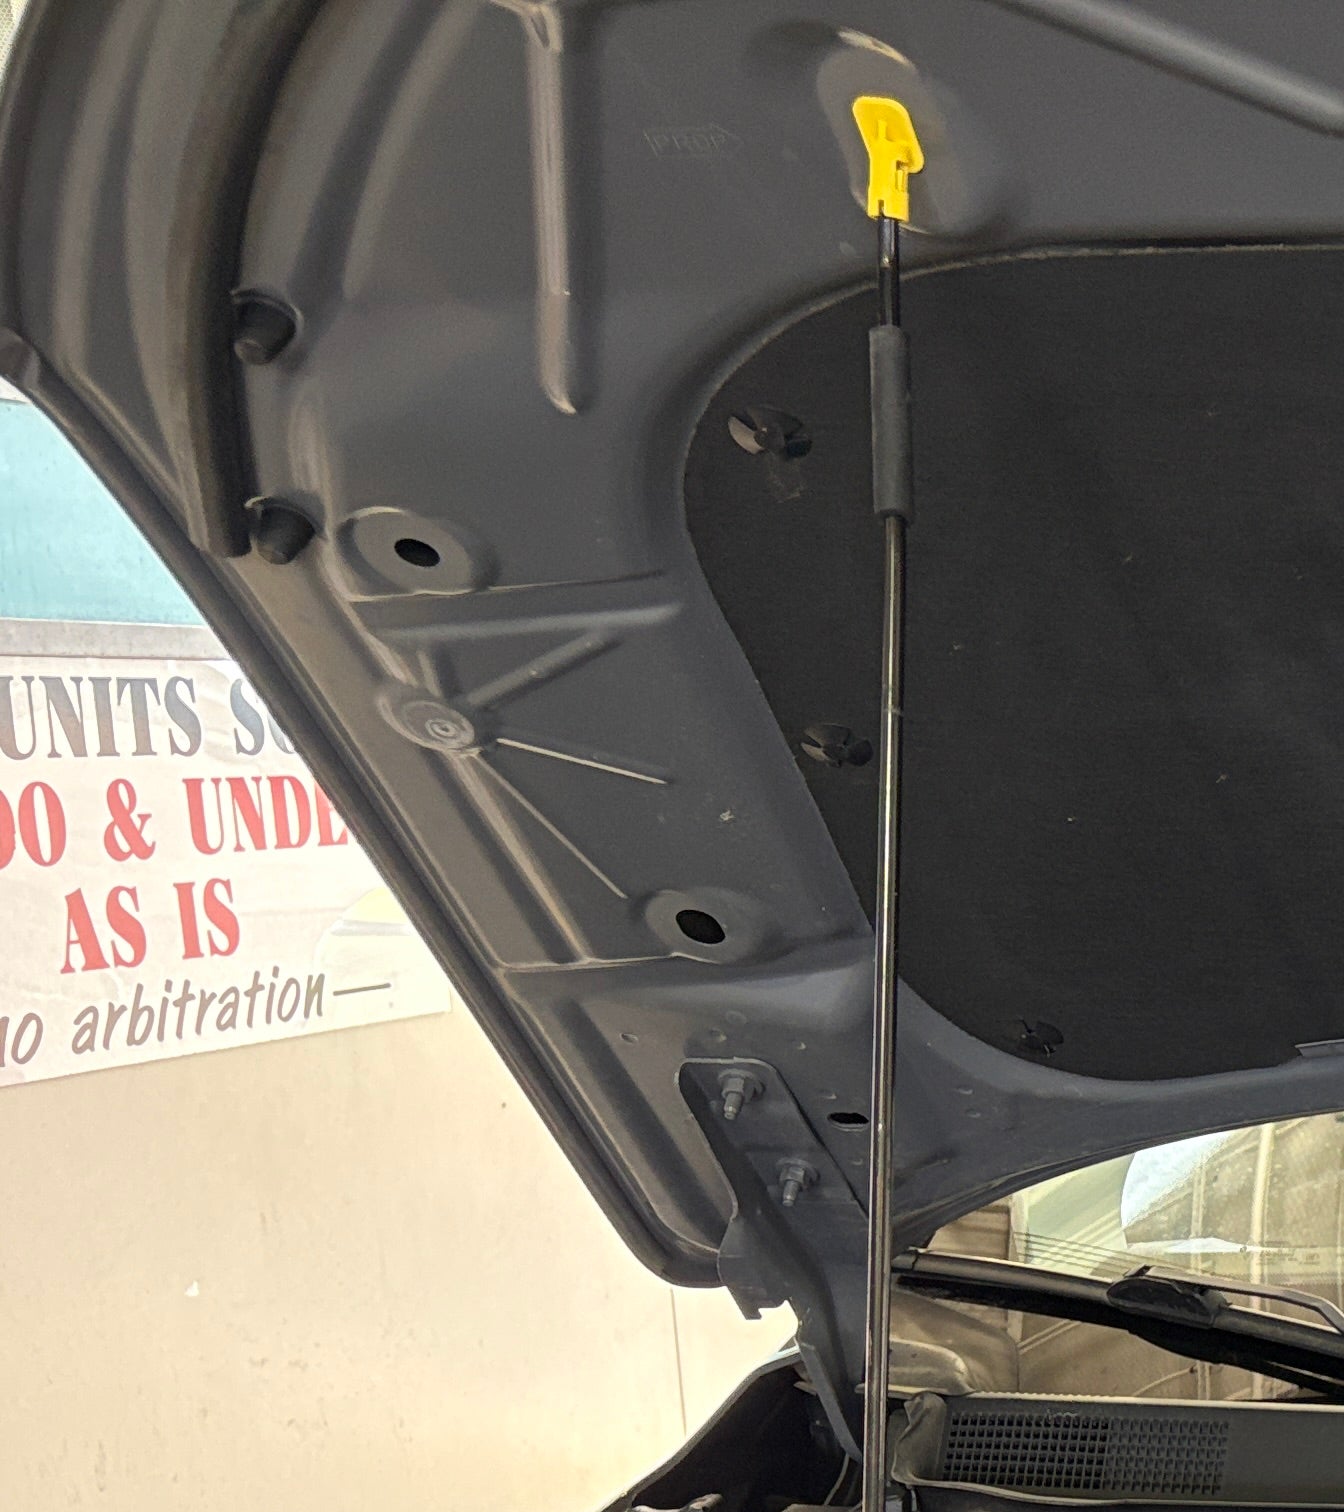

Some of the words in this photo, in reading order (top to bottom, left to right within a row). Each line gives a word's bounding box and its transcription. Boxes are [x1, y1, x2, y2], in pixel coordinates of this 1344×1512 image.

[0, 675, 202, 761] UNITS
[103, 778, 156, 863] &
[60, 884, 148, 974] AS
[173, 877, 240, 960] IS
